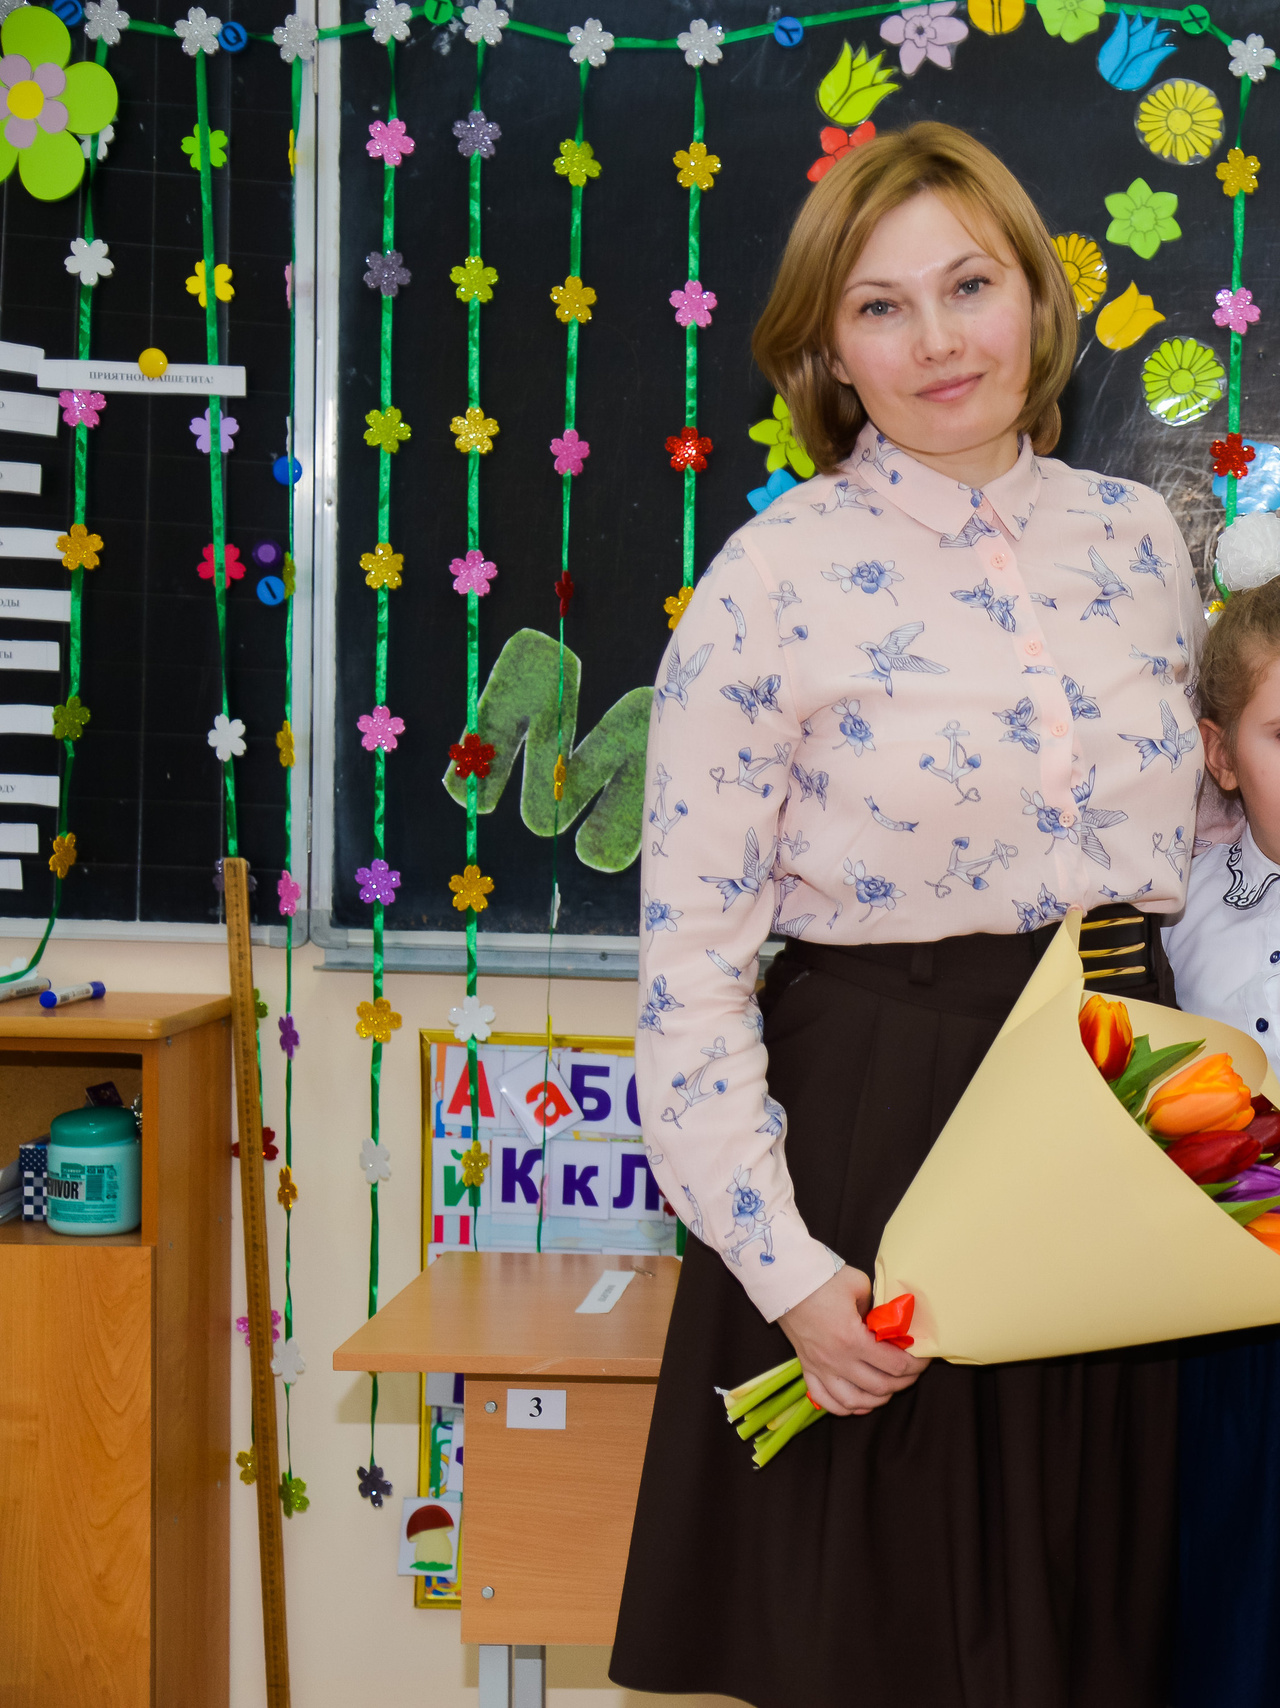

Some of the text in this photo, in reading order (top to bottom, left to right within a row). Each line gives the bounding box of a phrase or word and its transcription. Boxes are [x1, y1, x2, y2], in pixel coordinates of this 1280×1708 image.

[446, 1060, 496, 1119] А
[525, 1080, 574, 1127] а
[569, 1064, 612, 1122] Б
[529, 1396, 543, 1418] 3
